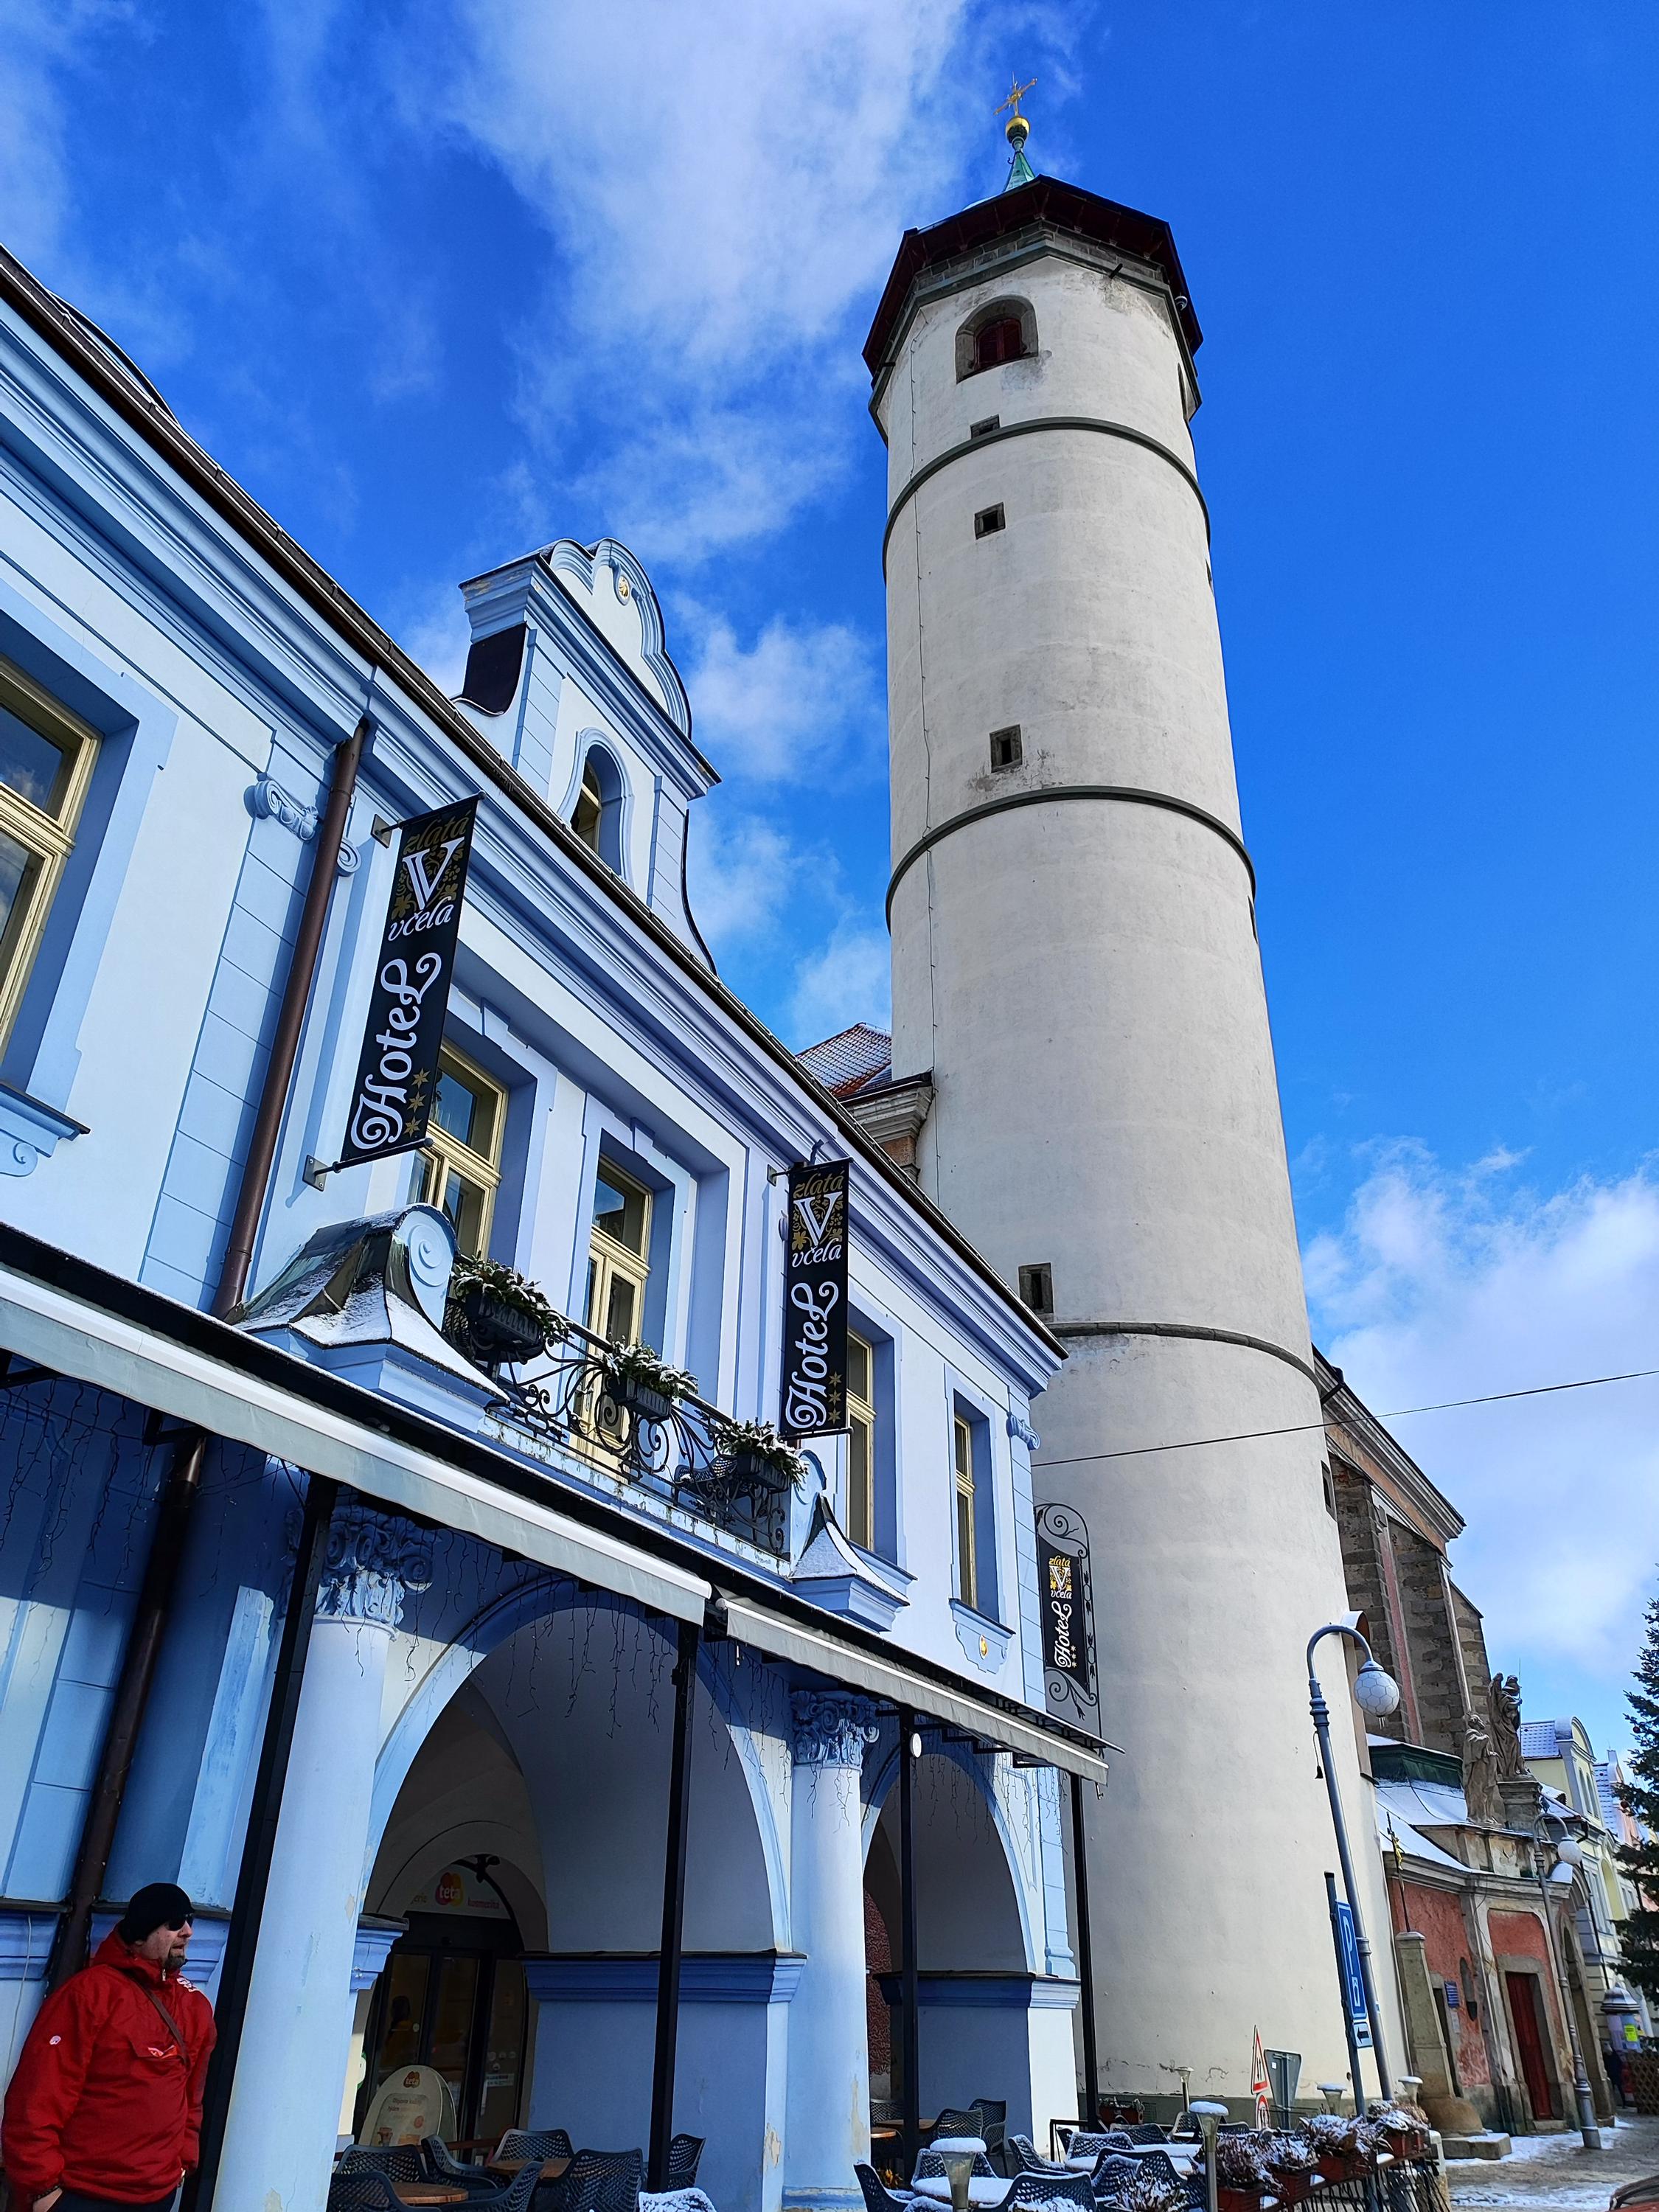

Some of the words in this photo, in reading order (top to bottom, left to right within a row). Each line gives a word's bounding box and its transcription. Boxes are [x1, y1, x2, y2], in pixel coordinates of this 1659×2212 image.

[403, 810, 471, 855] zlatá
[387, 897, 453, 942] včela
[793, 1169, 844, 1198] zlatá
[792, 1237, 841, 1267] včela
[1048, 1554, 1071, 1568] zlatá
[1050, 1588, 1072, 1599] včela
[439, 1885, 461, 1899] teta
[1343, 1916, 1354, 1975] P
[406, 2078, 420, 2086] teta
